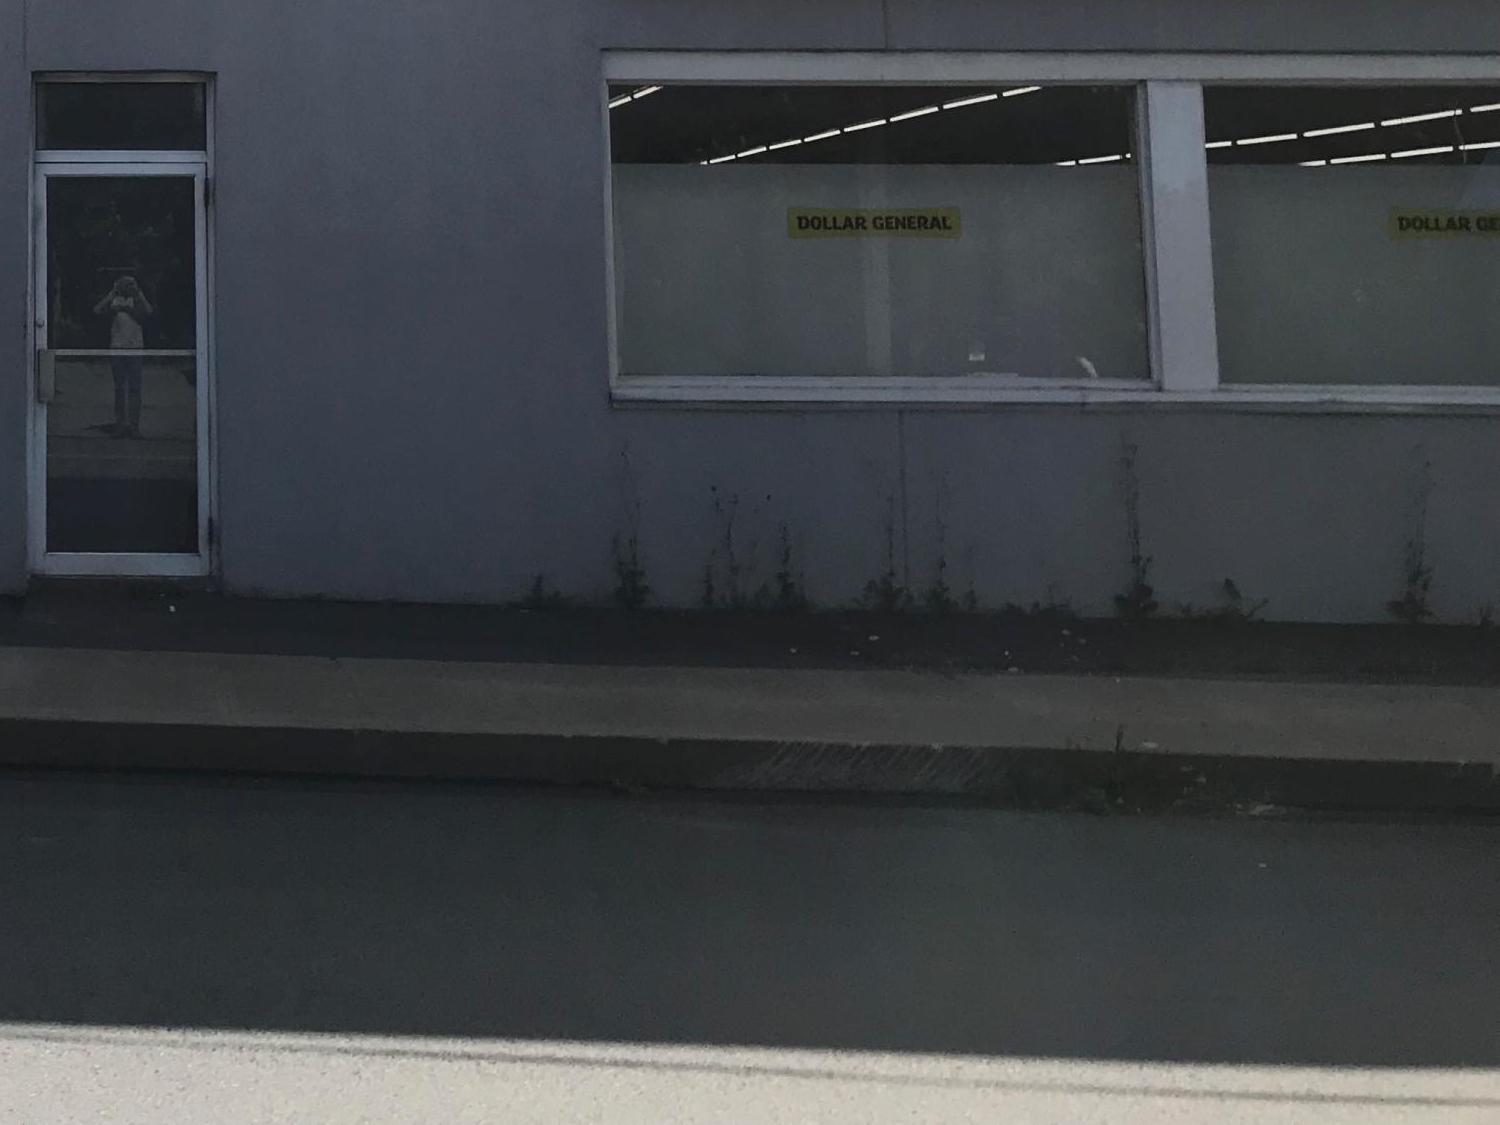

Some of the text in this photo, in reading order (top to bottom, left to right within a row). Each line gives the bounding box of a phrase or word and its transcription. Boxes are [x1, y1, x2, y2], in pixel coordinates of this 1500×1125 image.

[797, 215, 953, 231] DOLLAR GENERAL
[1397, 216, 1471, 231] DOLLAR
